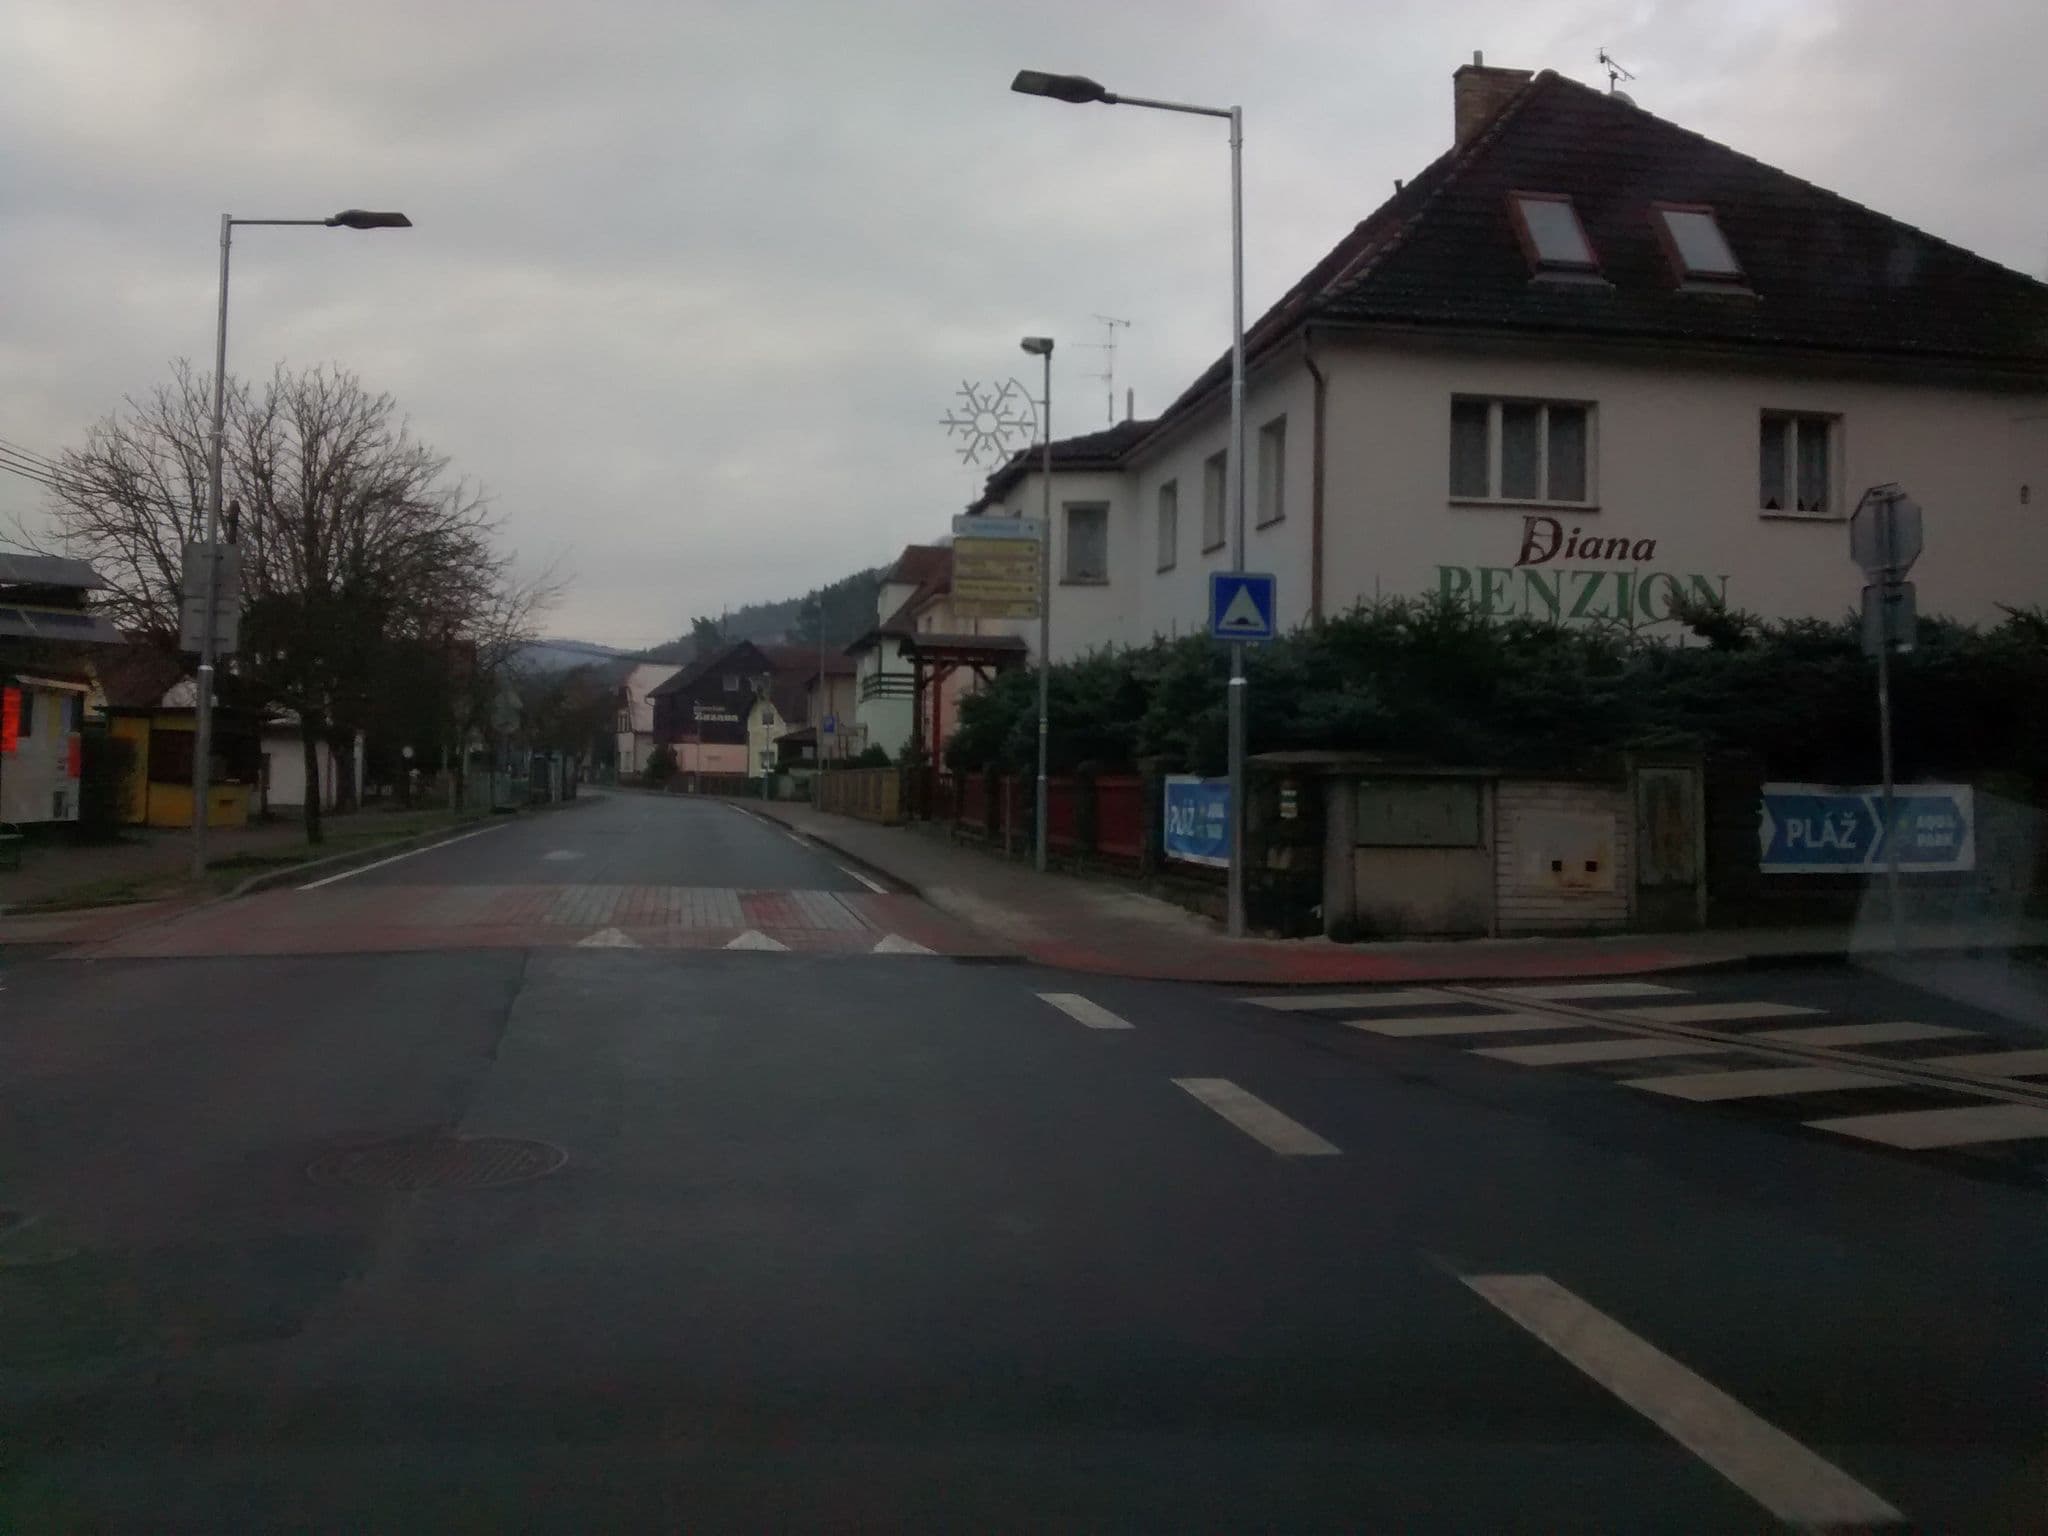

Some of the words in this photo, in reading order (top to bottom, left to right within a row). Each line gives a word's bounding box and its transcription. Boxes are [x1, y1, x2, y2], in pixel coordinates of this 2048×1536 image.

[1515, 515, 1656, 566] Diana
[1437, 565, 1731, 620] PENZION
[1786, 811, 1857, 849] PLÁŽ
